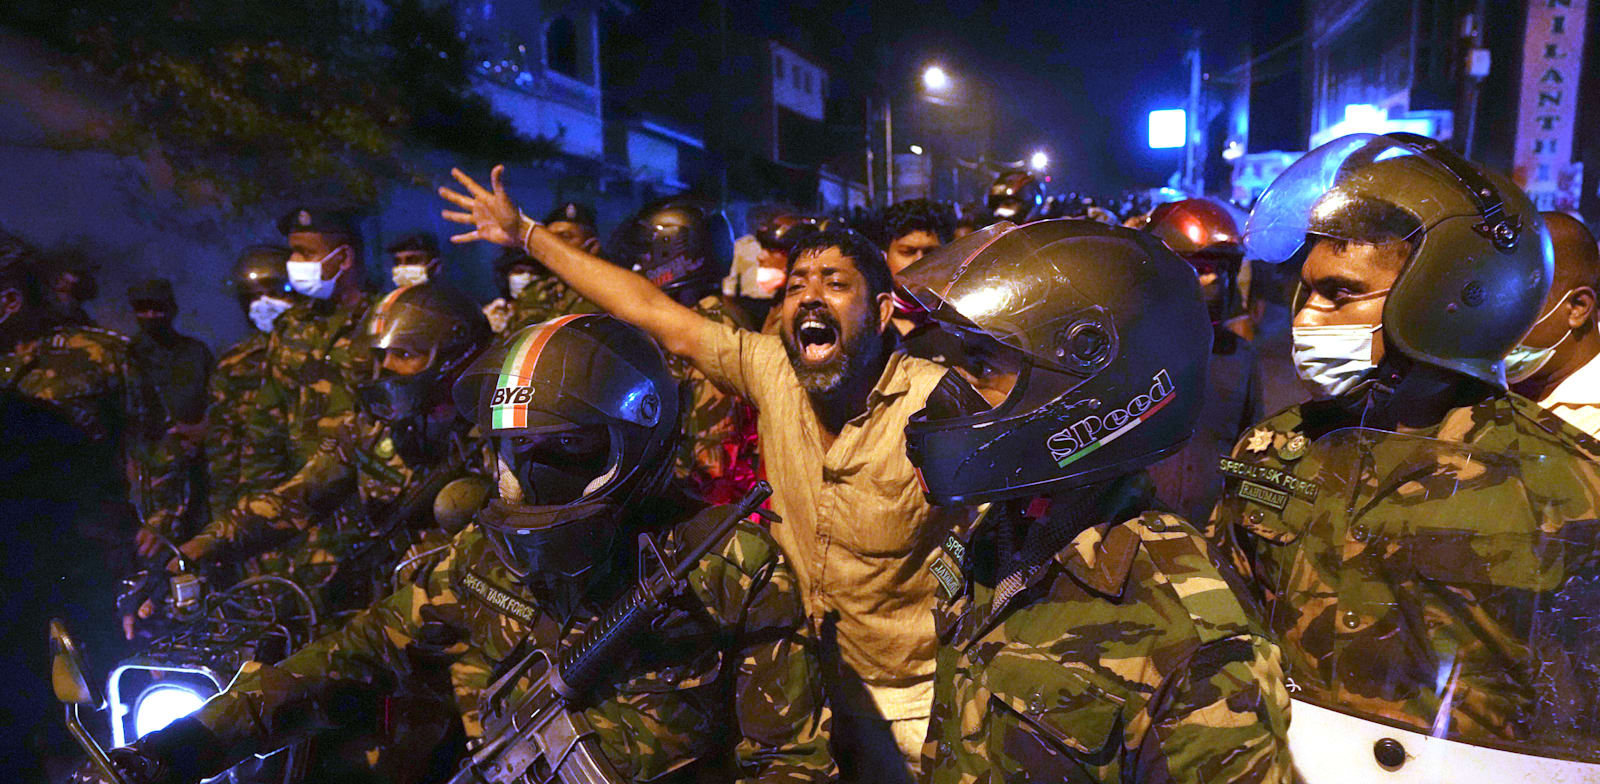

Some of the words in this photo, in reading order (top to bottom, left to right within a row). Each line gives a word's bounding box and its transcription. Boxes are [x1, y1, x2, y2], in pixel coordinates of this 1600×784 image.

[491, 386, 535, 407] BYB
[487, 588, 510, 609] TASK
[506, 599, 534, 620] FORCE
